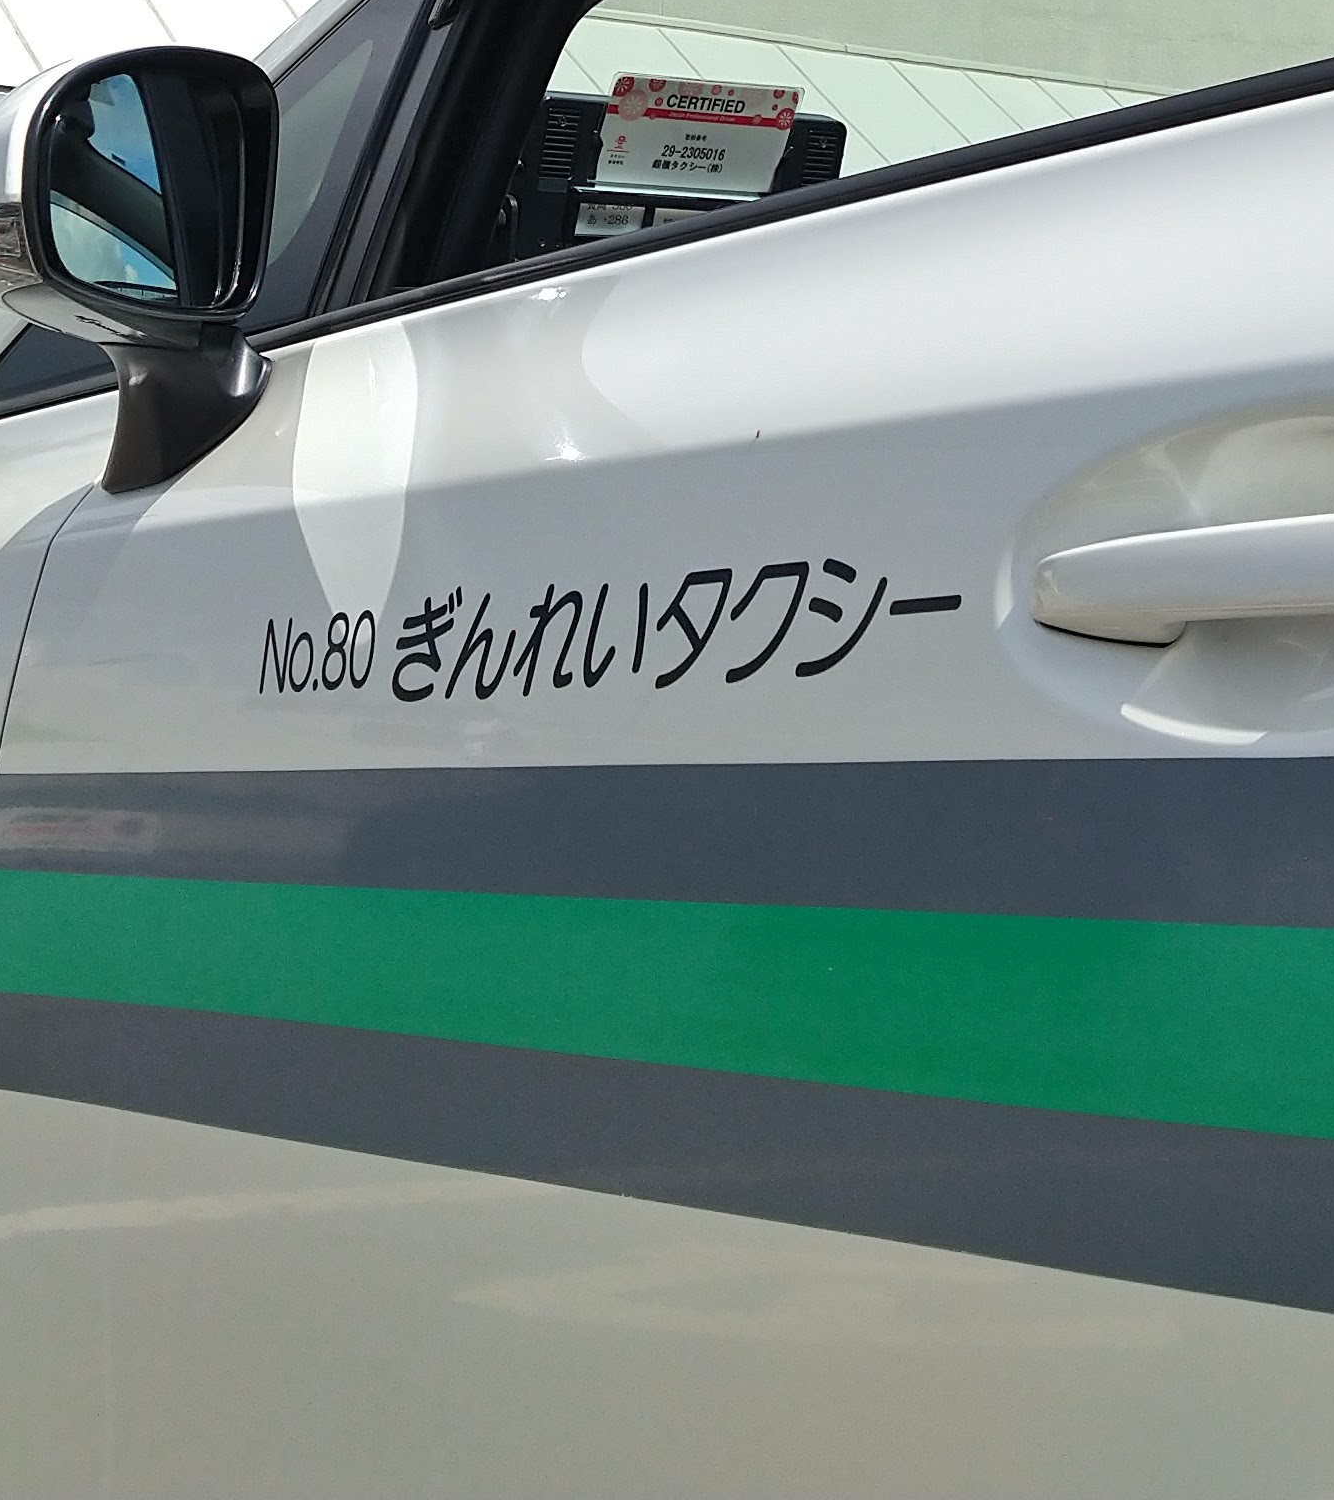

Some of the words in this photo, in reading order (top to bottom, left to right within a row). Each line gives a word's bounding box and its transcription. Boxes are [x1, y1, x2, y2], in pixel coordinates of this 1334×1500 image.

[666, 94, 746, 115] CERTIFIED
[661, 144, 726, 162] 29-2305016
[258, 609, 377, 695] No.80
[390, 557, 963, 703] ぎんれいタクシー
